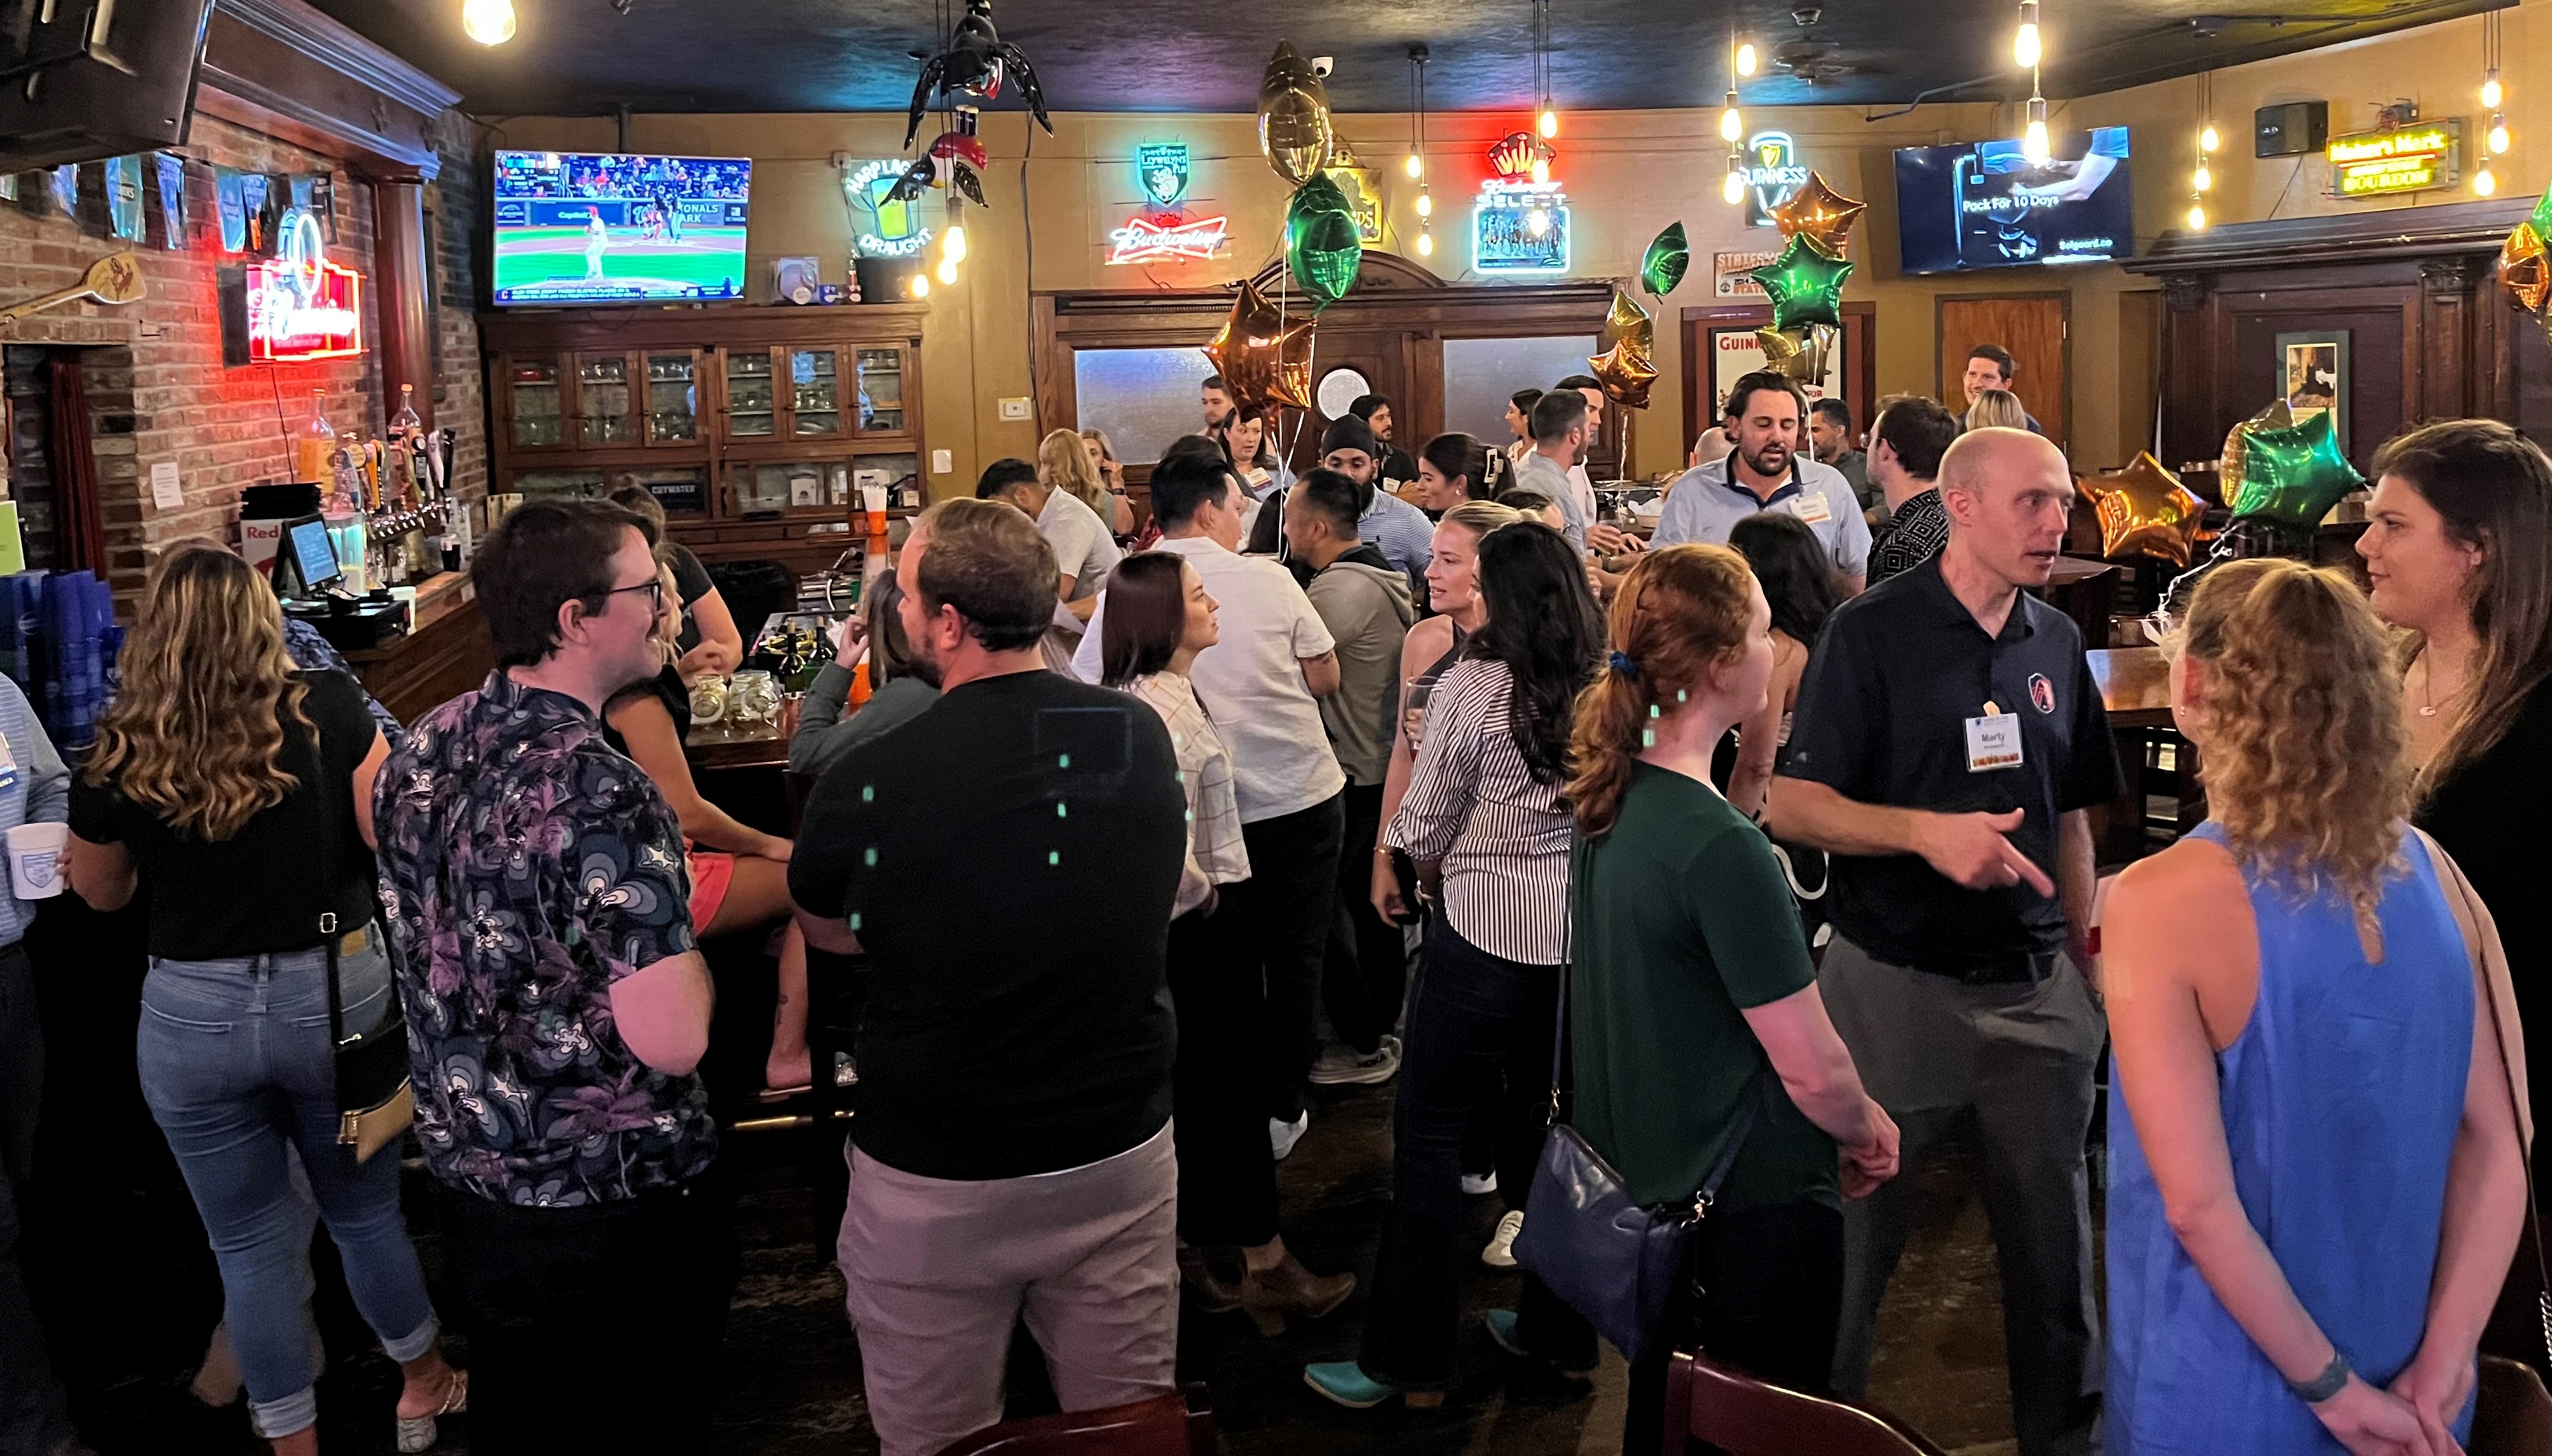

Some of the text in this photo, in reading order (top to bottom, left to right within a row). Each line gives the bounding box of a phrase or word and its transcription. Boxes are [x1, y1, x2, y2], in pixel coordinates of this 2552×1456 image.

[2395, 131, 2445, 153] Mark
[846, 158, 912, 195] HARP LAG
[1739, 166, 1807, 185] GUINNESS
[2344, 169, 2431, 192] BOURBON
[1962, 194, 2059, 212] Pack For 10 Days
[859, 227, 932, 256] DRAUGHT
[1111, 227, 1227, 250] Budweiser
[1719, 336, 1763, 351] GUINN
[246, 525, 279, 539] Red
[1981, 732, 2006, 743] Marty
